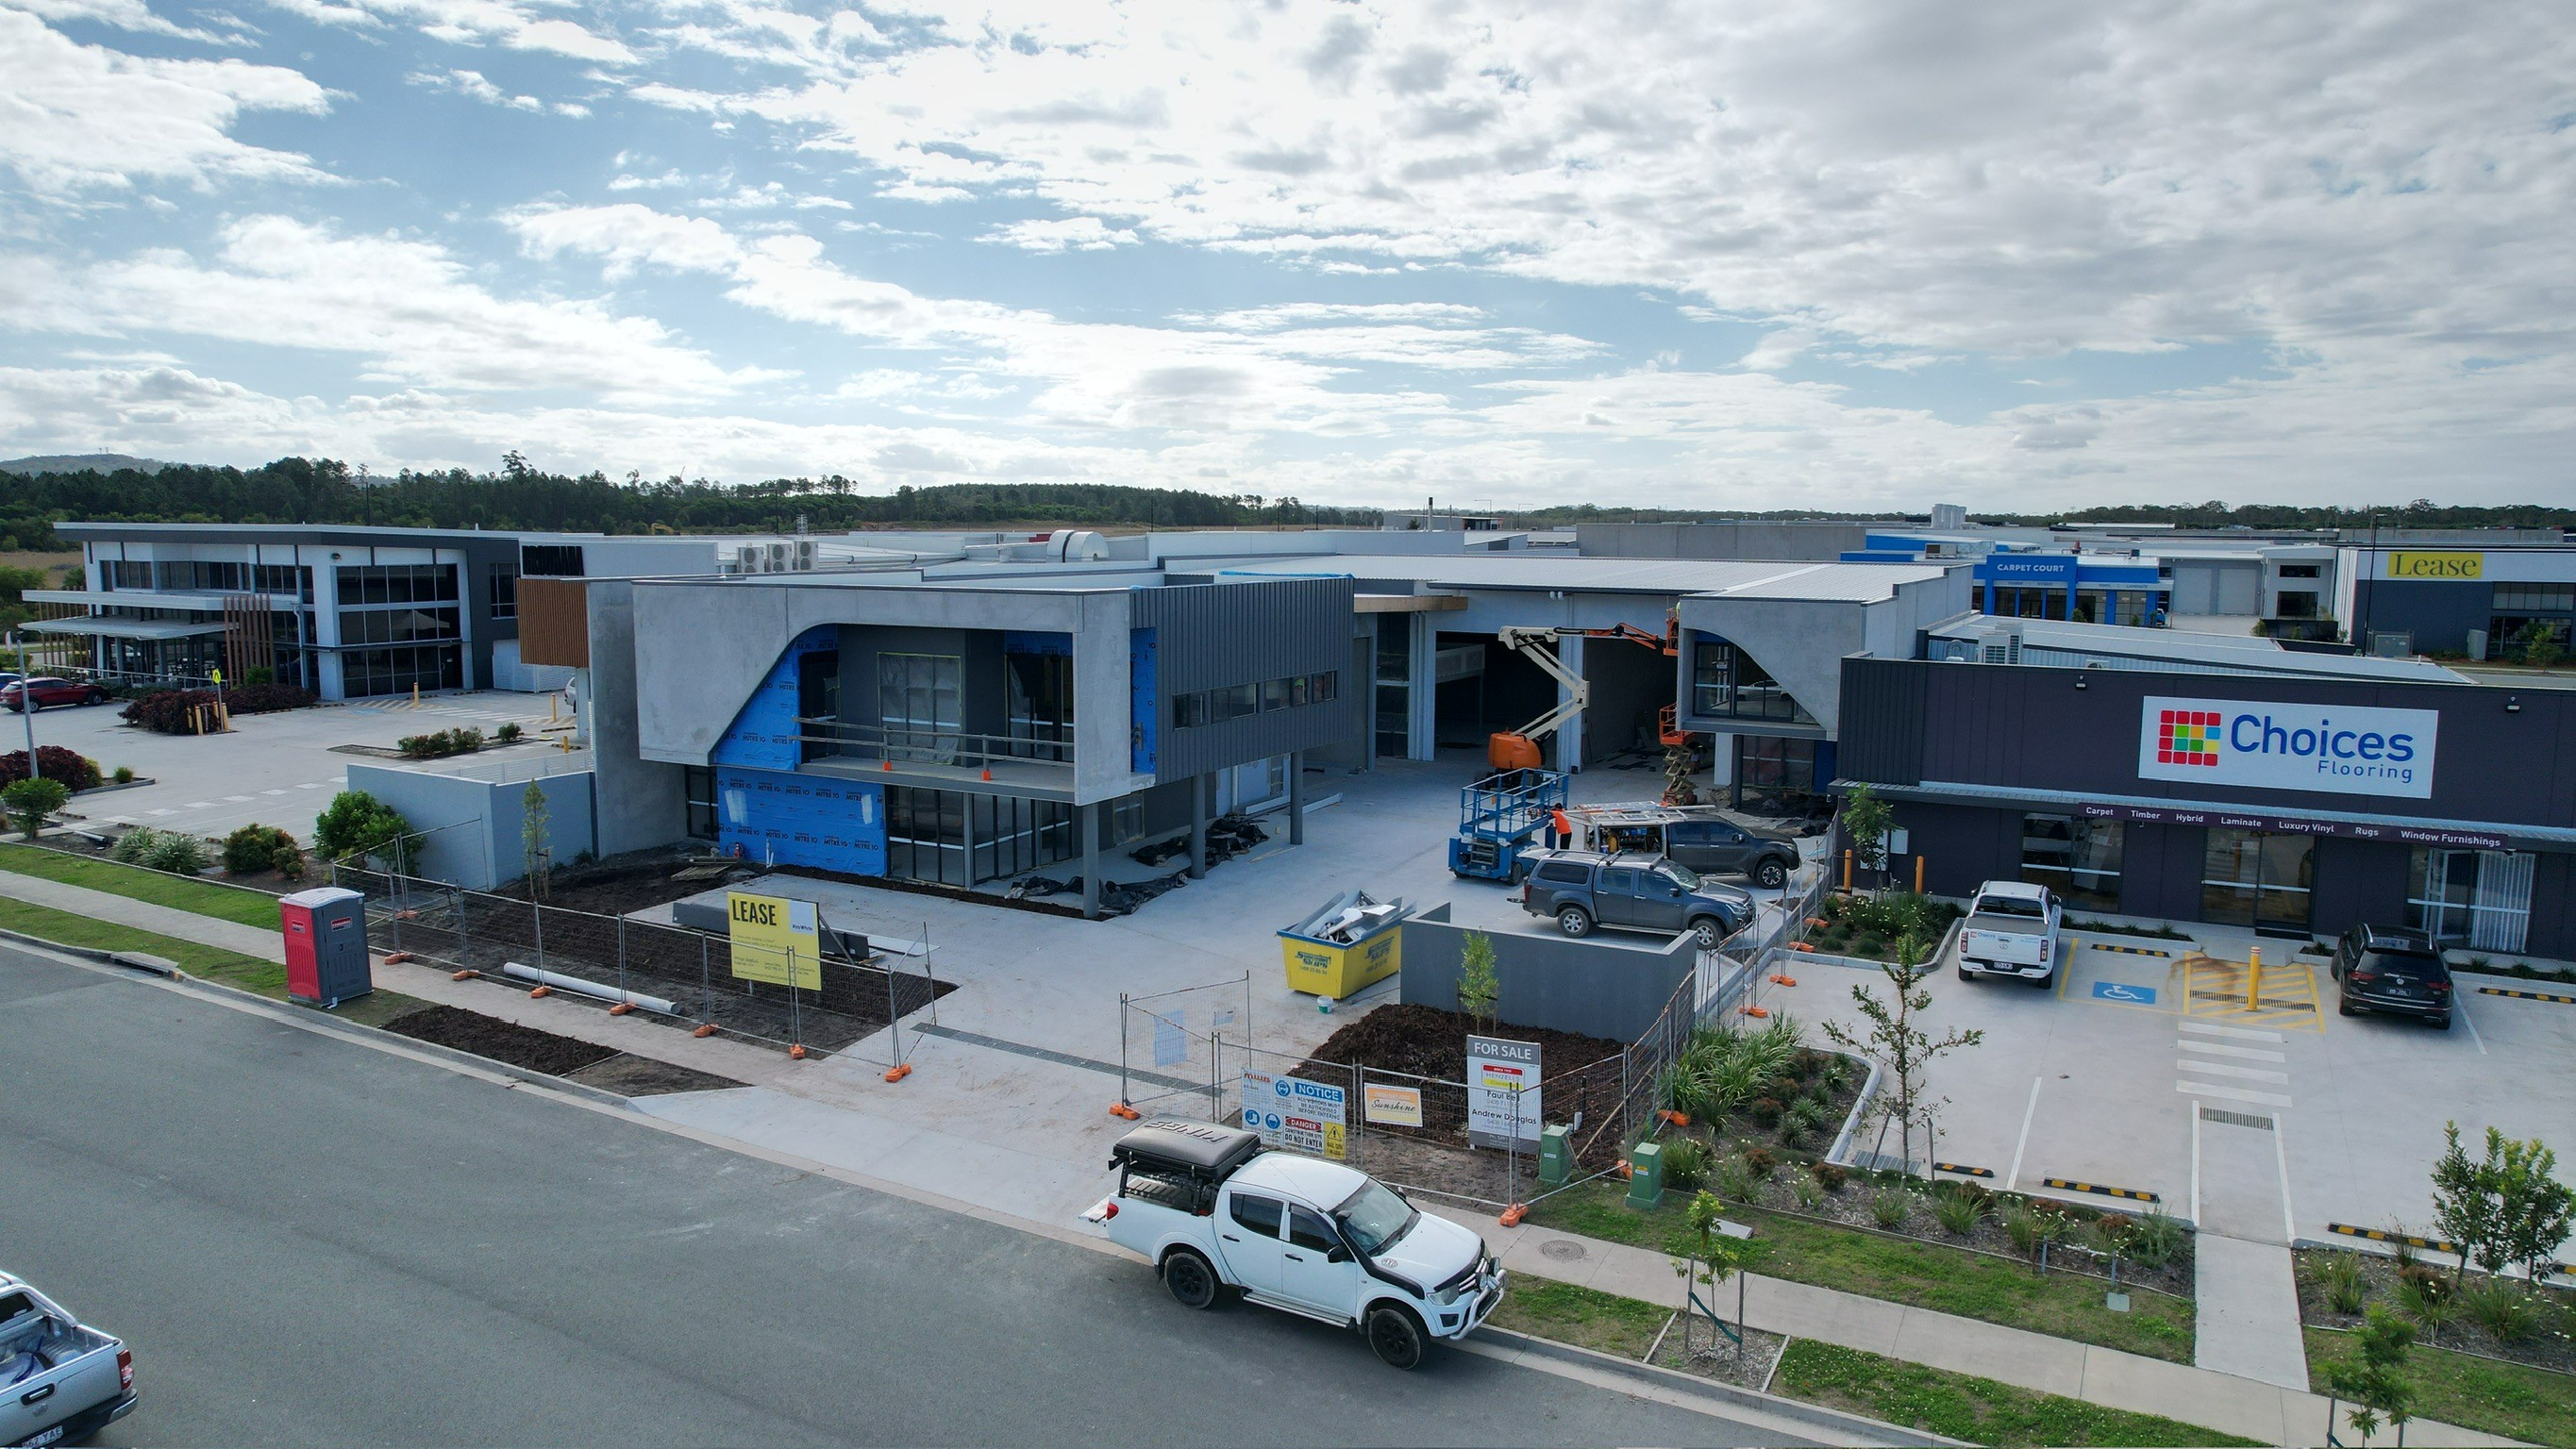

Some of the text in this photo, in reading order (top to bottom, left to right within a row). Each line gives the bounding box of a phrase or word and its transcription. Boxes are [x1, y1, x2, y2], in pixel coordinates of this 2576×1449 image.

[1997, 563, 2065, 573] CARPET COURT
[2394, 553, 2477, 576] Lease
[772, 737, 788, 745] MITRE
[2231, 714, 2415, 762] Choices
[2317, 760, 2413, 784] Flooring
[2085, 807, 2501, 848] Carpet Timber Hybrid Laminate Luxury Vinyl Rugs Window Furnishings
[731, 898, 778, 926] LEASE
[1474, 1041, 1532, 1060] FOR SALE
[1298, 1084, 1339, 1101] NOTICE
[1486, 1091, 1504, 1099] Paul
[1371, 1098, 1416, 1112] Sunshine
[1472, 1108, 1502, 1119] Andrew
[1291, 1119, 1316, 1129] DANGER
[1294, 1136, 1304, 1144] NOT
[1306, 1138, 1323, 1148] ENTER
